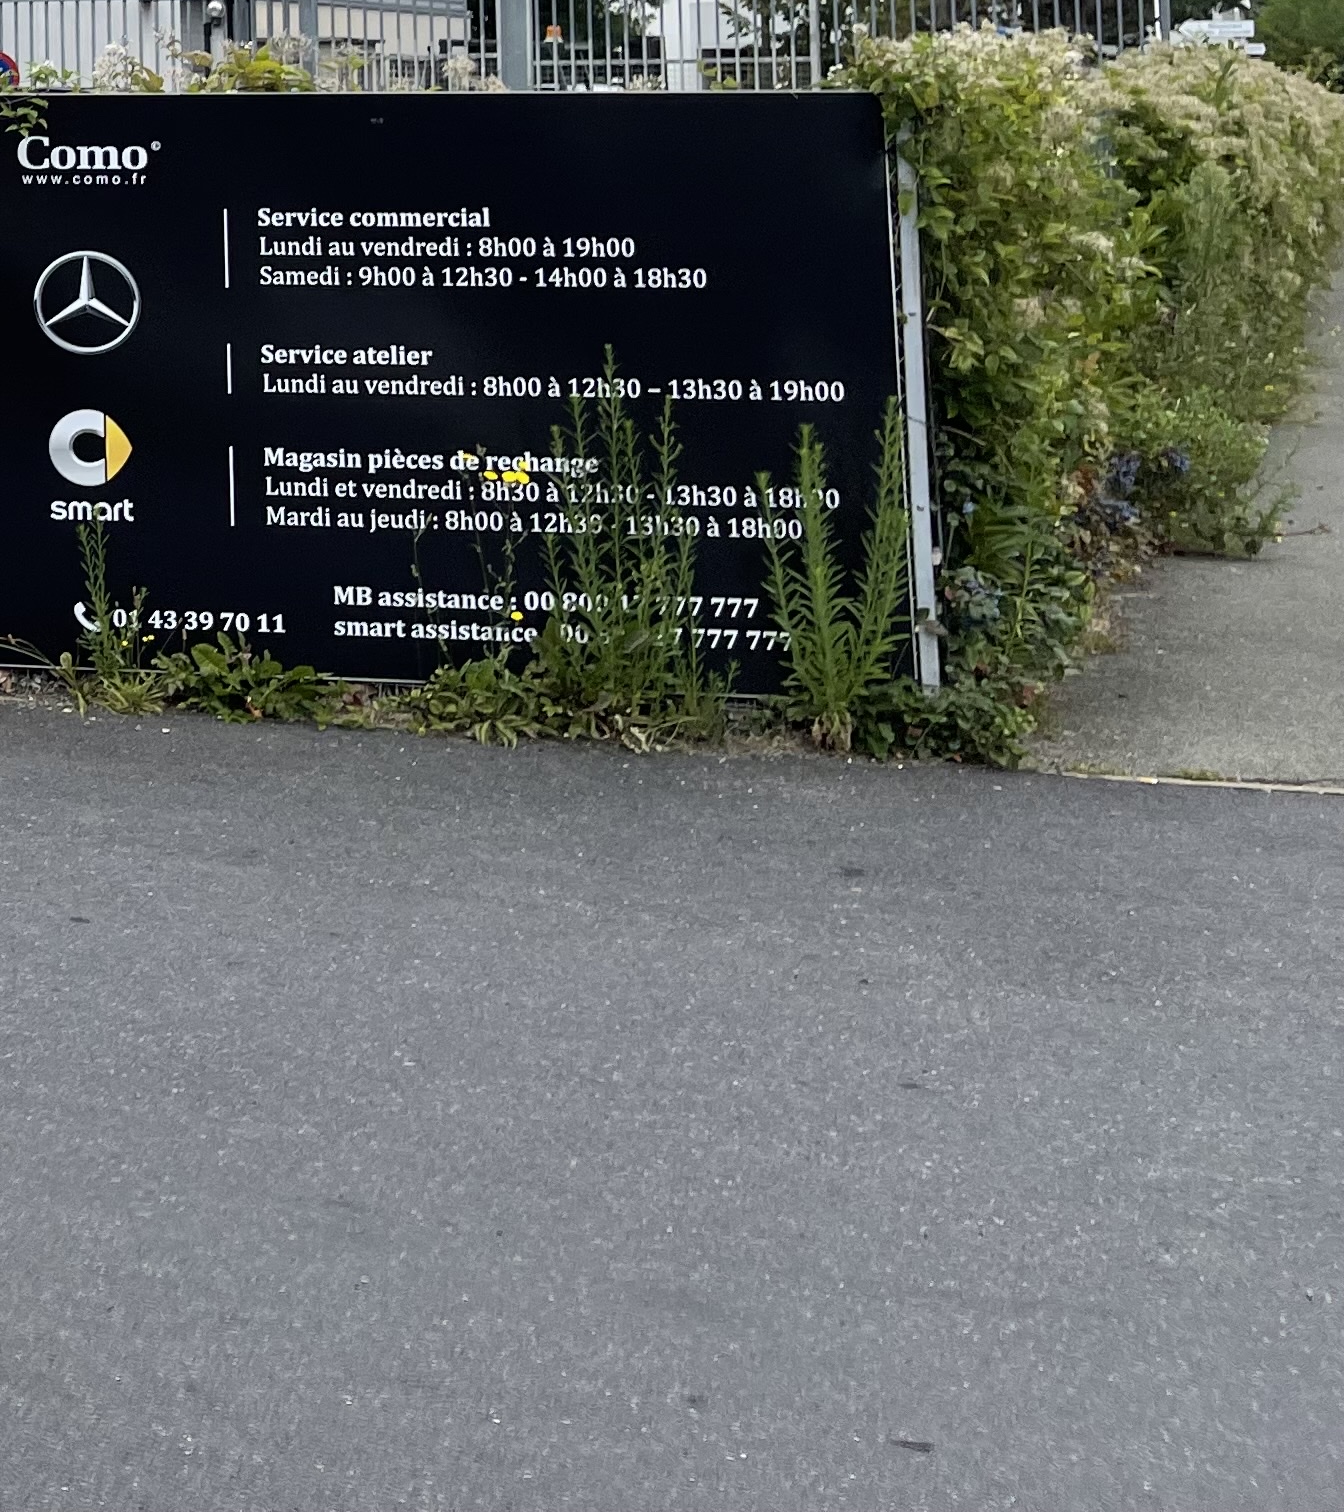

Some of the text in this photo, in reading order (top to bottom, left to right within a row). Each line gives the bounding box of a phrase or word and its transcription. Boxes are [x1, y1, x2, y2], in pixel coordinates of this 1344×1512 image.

[17, 135, 149, 170] Como
[21, 172, 147, 185] www.como.fr
[257, 207, 491, 228] Service commercial
[259, 236, 323, 257] Lundi
[328, 241, 355, 257] au
[361, 237, 460, 258] vendredi
[478, 237, 536, 258] 8h00
[543, 237, 557, 258] à
[563, 238, 635, 258] 19h00
[259, 266, 340, 286] Samedi
[359, 267, 415, 287] 9h00
[422, 267, 435, 287] à
[442, 267, 513, 287] 12h30
[536, 267, 607, 288] 14h00
[613, 267, 627, 288] à
[634, 268, 707, 289] 18h30
[260, 345, 433, 366] Service atelier
[263, 373, 326, 394] Lundi
[332, 379, 359, 395] au
[364, 375, 464, 396] vendredi
[483, 376, 541, 397] 8h00
[548, 376, 561, 397] à
[568, 377, 641, 399] 12h30
[668, 379, 742, 400] 13h30
[749, 379, 763, 401] à
[769, 380, 845, 402] 19h00
[263, 447, 599, 478] Magasin pièces de rechange
[265, 476, 327, 497] Lundi
[333, 480, 357, 498] et
[362, 479, 462, 500] vendredi
[481, 480, 540, 502] 8h30
[546, 483, 560, 503] à
[665, 485, 737, 507] 13h30
[744, 486, 757, 507] à
[766, 487, 840, 509] 18h0
[50, 499, 135, 522] smart
[266, 506, 331, 527] Mardi
[337, 513, 364, 528] au
[370, 508, 426, 533] jeudi
[445, 511, 503, 532] 8h00
[509, 511, 523, 533] à
[626, 515, 700, 537] 13h30
[706, 517, 721, 538] à
[727, 518, 803, 540] 18h00
[333, 586, 373, 606] MB
[378, 588, 504, 610] assistance
[524, 591, 555, 611] 00
[710, 597, 759, 618] 777
[113, 608, 287, 634] 01 43 39 70 11
[333, 620, 406, 638] smart
[411, 620, 538, 643] assistance
[691, 628, 738, 650] 777
[746, 629, 792, 651] 777
